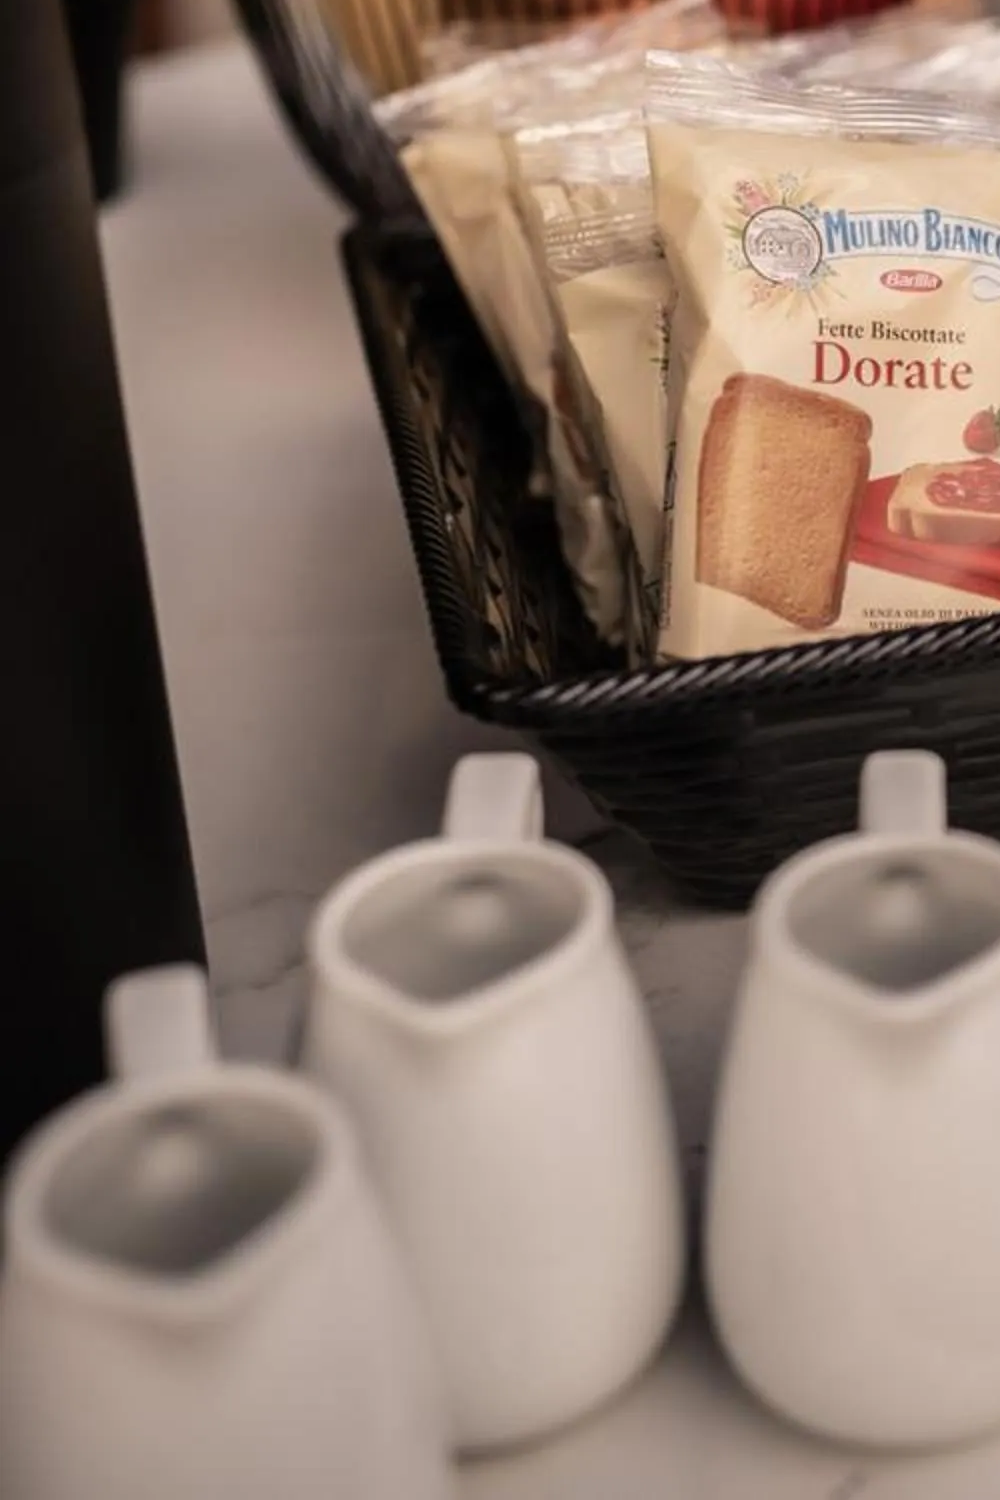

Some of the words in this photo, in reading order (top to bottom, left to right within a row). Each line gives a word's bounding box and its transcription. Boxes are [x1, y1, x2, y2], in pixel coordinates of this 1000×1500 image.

[823, 208, 920, 254] MULINO
[818, 318, 865, 339] Fette
[871, 321, 966, 345] Biscottate
[812, 340, 974, 391] Dorate
